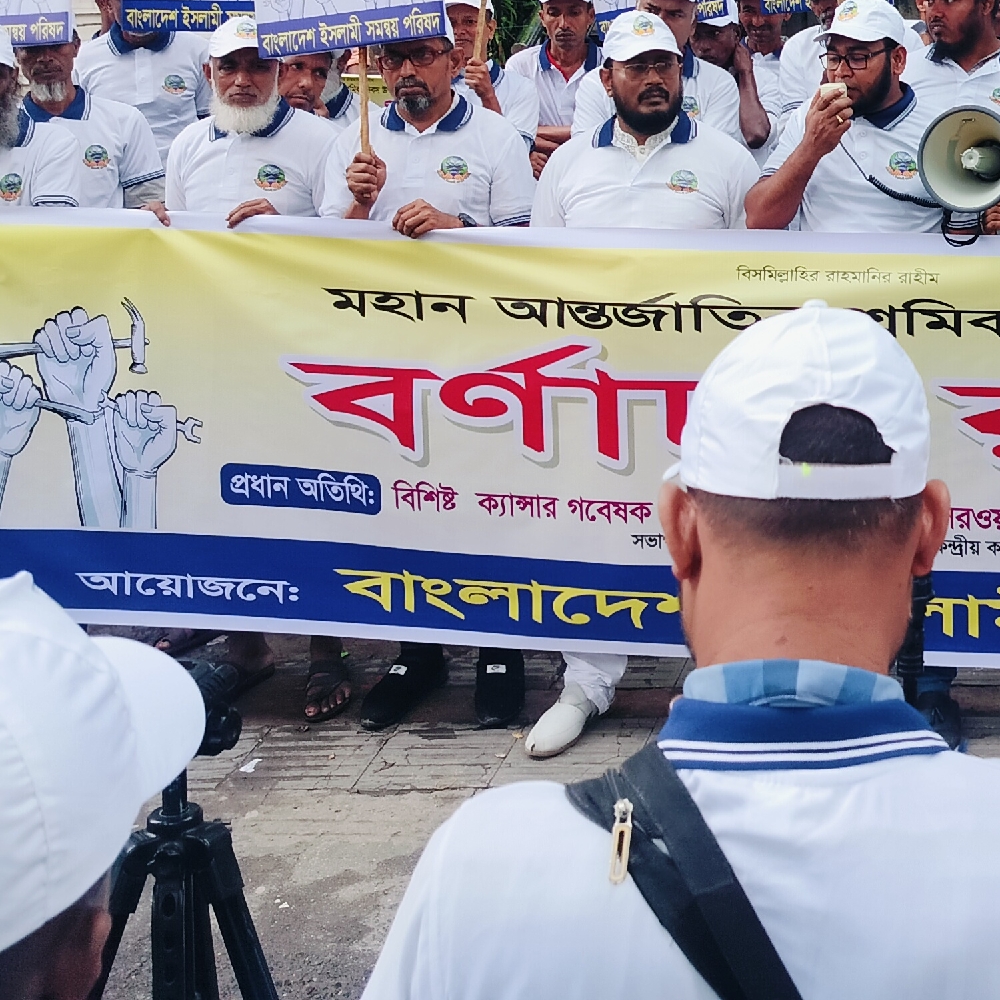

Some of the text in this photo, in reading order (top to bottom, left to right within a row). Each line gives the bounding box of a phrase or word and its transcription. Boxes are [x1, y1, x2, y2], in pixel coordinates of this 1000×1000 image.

[897, 268, 940, 285] রাহীম
[321, 286, 475, 323] মহান
[491, 292, 775, 333] আন্তর্জাতি
[286, 343, 699, 462] বর্ণা
[230, 472, 291, 500] প্রধান
[295, 472, 375, 507] অতিথি:
[391, 479, 459, 512] বিশিষ্ট
[475, 492, 560, 520] ক্যান্সার
[567, 496, 654, 524] গবেষক
